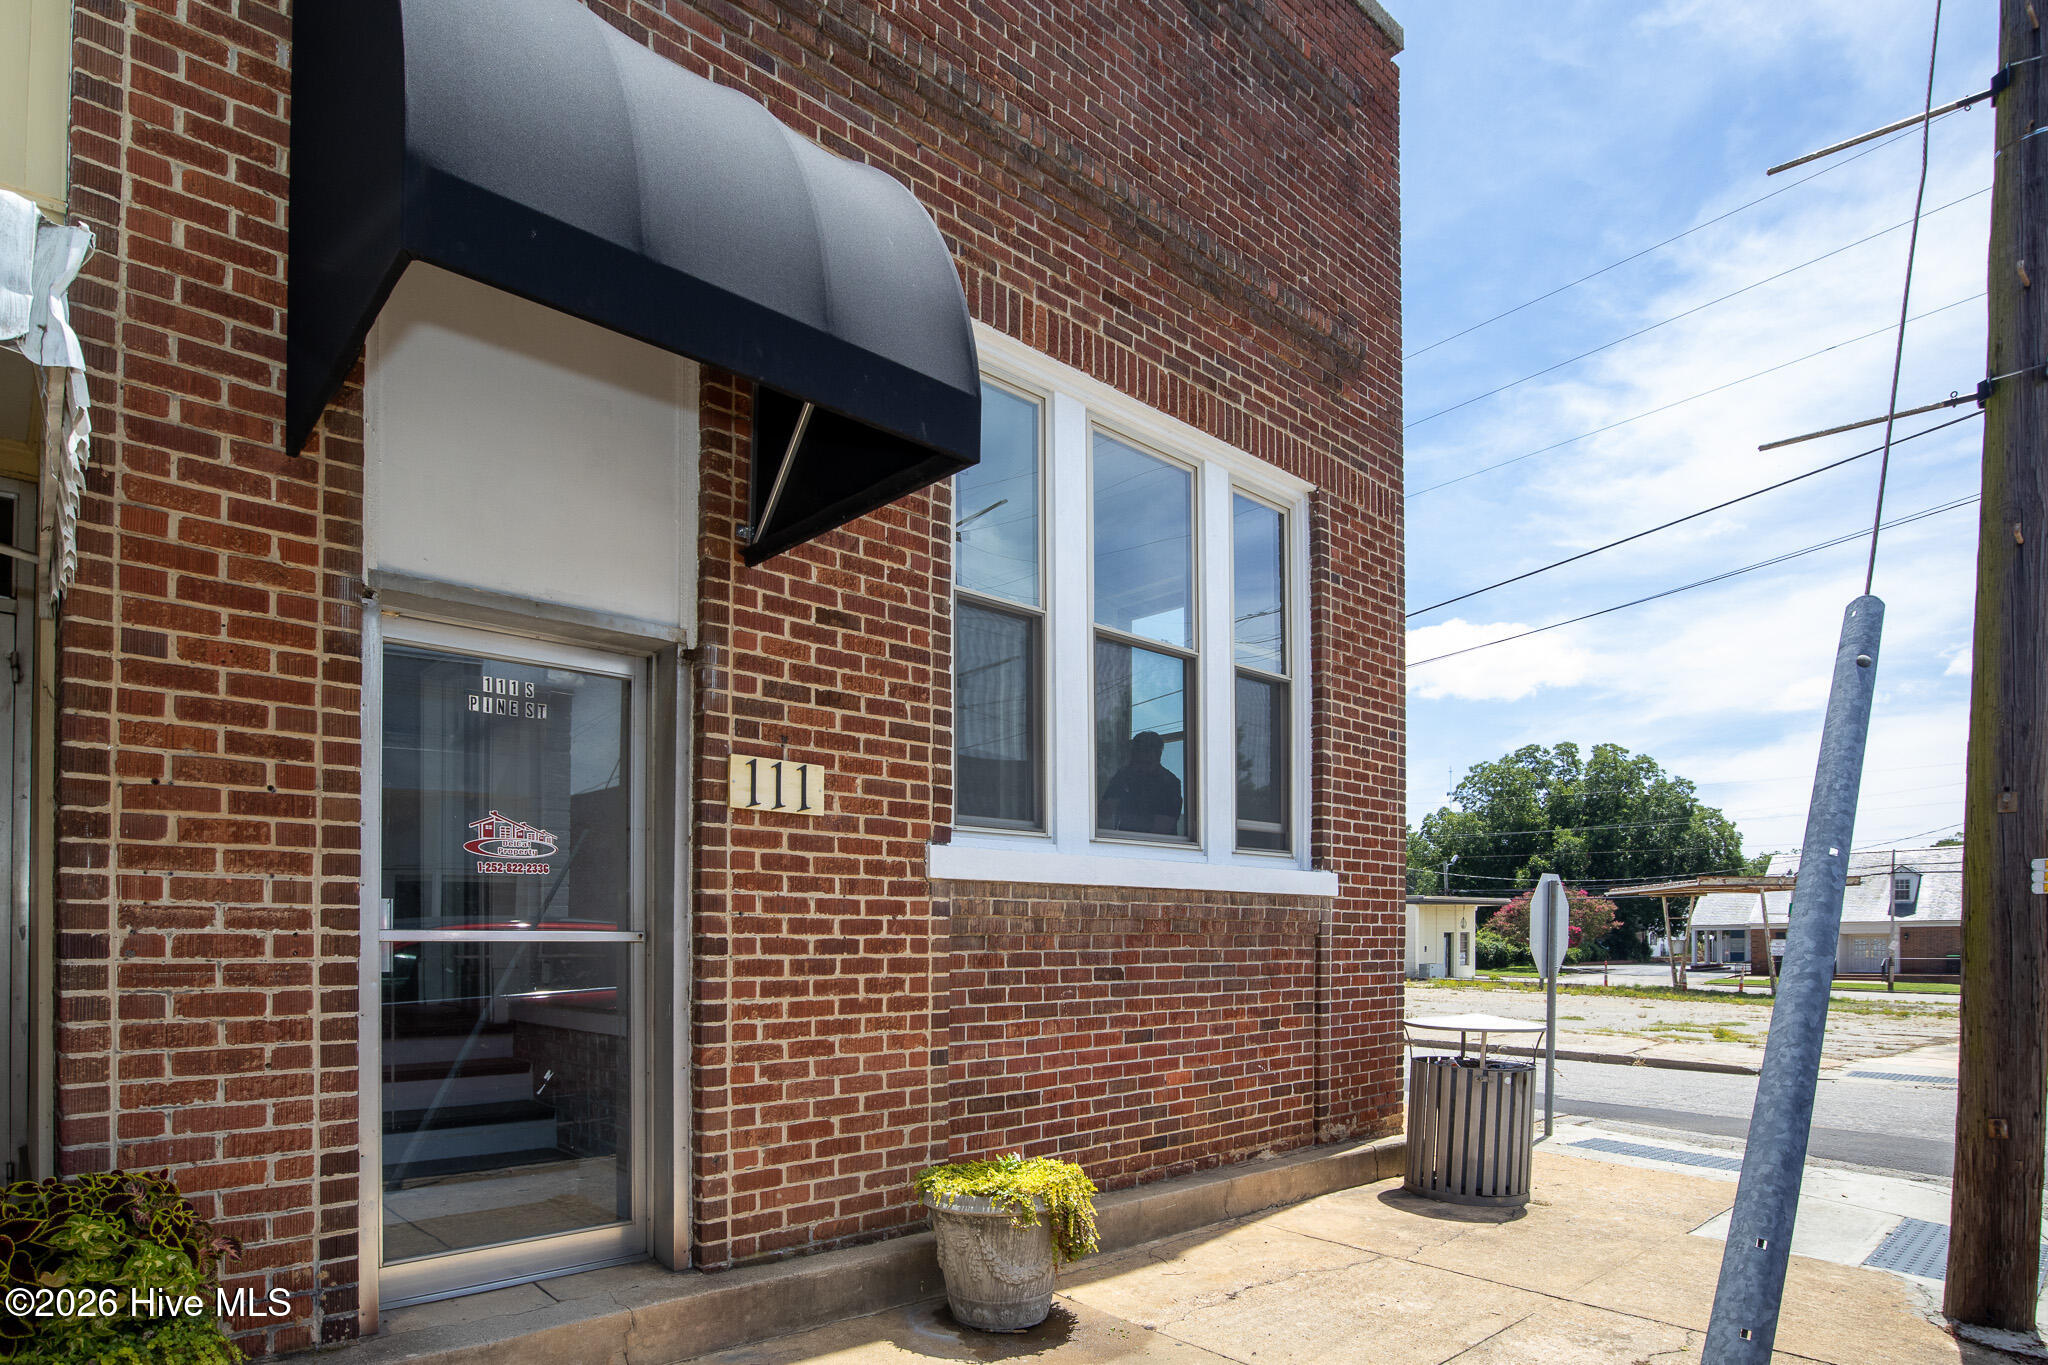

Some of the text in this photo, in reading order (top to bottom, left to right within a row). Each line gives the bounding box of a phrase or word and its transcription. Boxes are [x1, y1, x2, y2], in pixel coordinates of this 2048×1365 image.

[483, 676, 535, 698] 111 S
[468, 695, 547, 719] PINE ST
[745, 758, 812, 812] 111
[498, 847, 538, 856] Property
